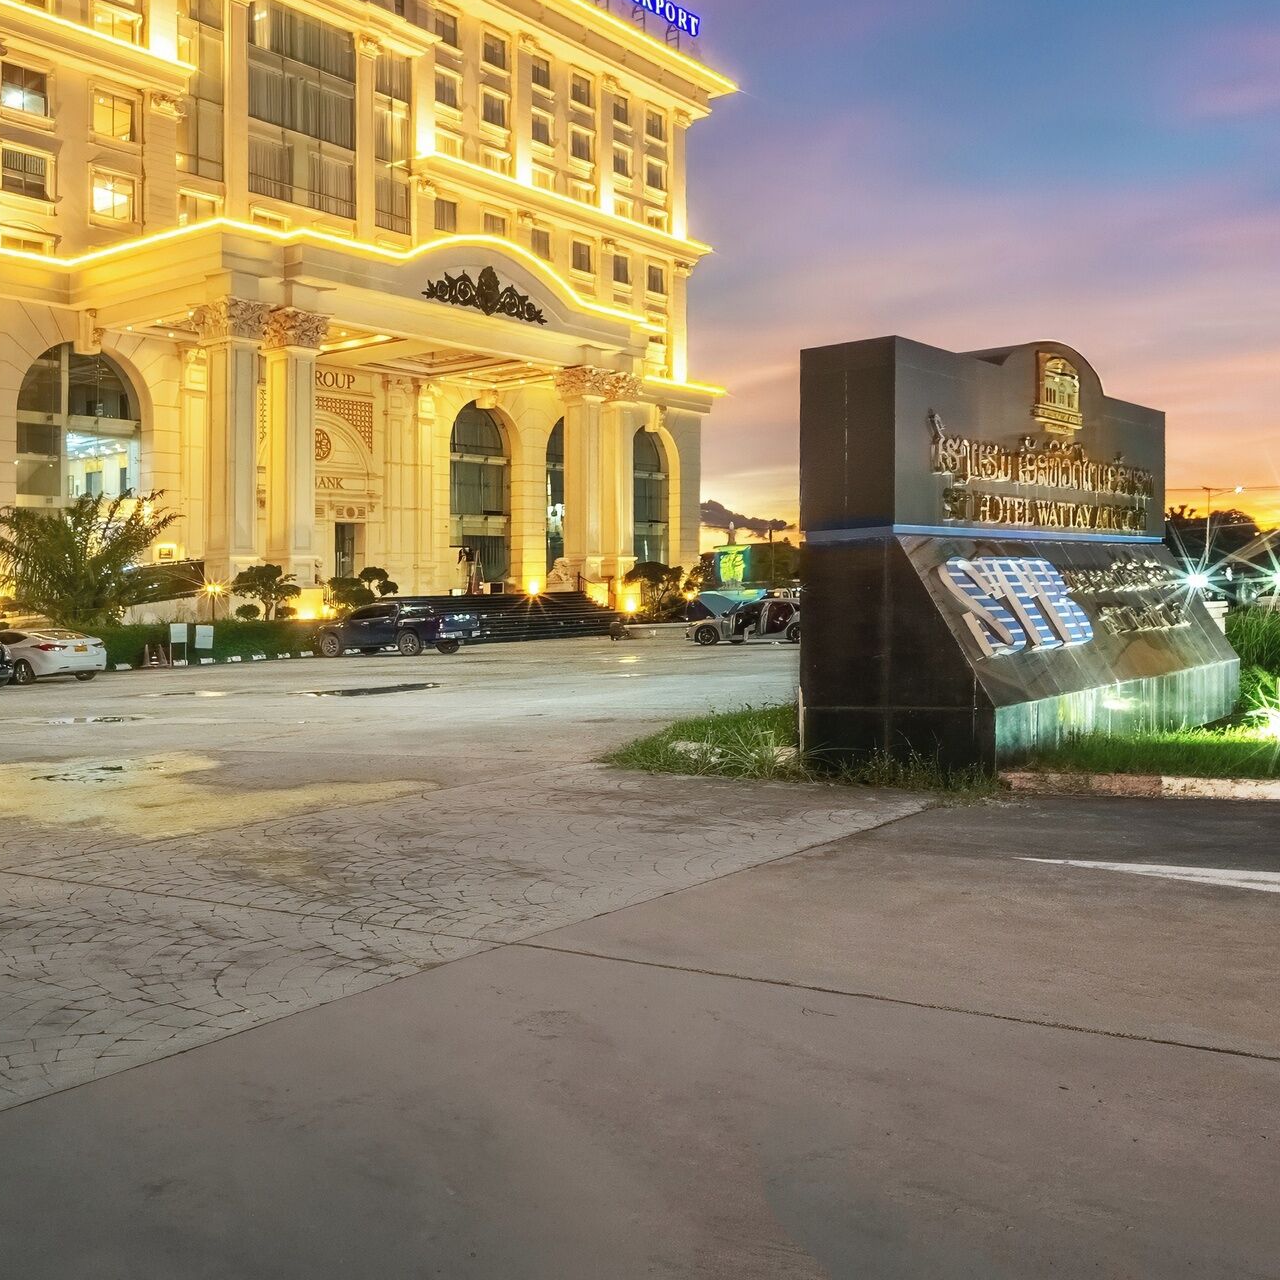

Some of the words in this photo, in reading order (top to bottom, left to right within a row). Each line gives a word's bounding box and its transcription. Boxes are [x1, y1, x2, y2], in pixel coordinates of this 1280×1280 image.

[315, 476, 345, 490] ANK
[980, 495, 1035, 526] HOTEL
[1036, 500, 1093, 529] WATTAY
